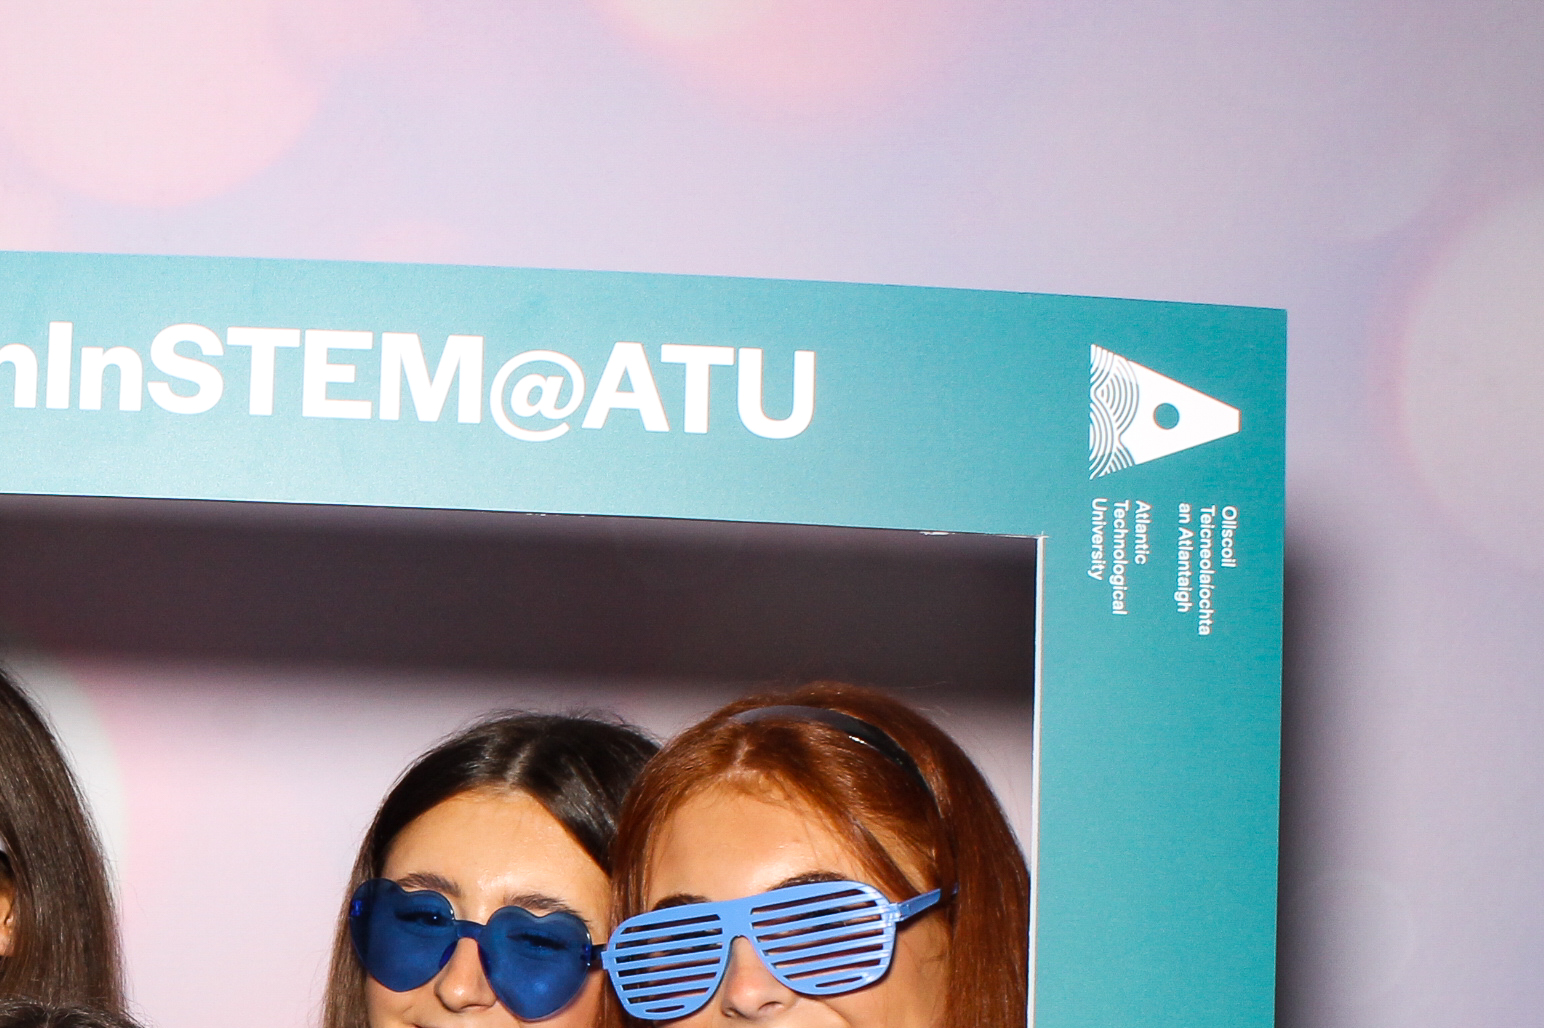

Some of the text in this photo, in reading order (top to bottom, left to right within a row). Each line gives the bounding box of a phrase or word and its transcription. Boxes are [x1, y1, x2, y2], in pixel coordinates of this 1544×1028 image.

[1087, 497, 1109, 581] University
[1109, 499, 1132, 615] Technological
[1134, 499, 1153, 565] Atlantic
[1173, 502, 1195, 613] an Atlantaigh
[1198, 504, 1217, 636] Teicneolaíochta
[1221, 505, 1239, 568] Ollscoil
